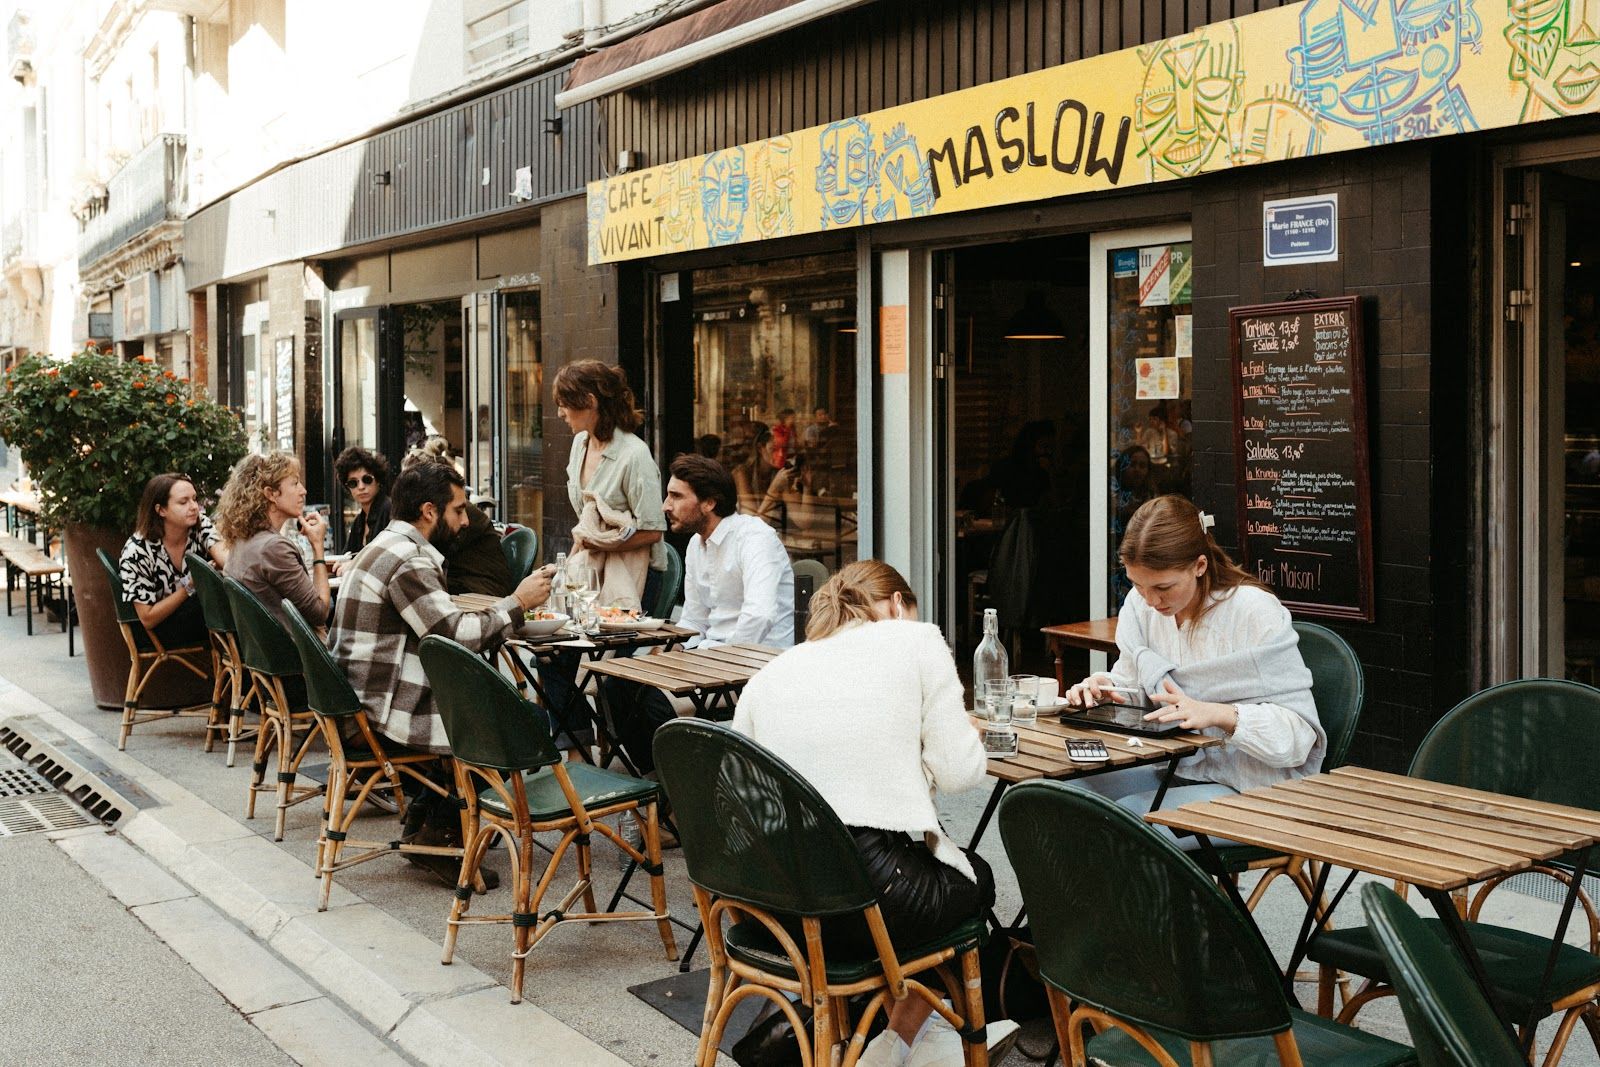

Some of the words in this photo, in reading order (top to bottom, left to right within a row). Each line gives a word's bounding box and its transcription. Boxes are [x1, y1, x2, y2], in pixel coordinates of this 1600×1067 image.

[927, 99, 1131, 199] MASLOW
[608, 172, 652, 213] CAFE
[600, 216, 664, 256] VIVANT
[1272, 222, 1289, 230] Marie
[1290, 220, 1314, 228] FRANCE
[1242, 318, 1276, 338] Tartines
[1314, 312, 1345, 326] EXTRAS
[1245, 440, 1280, 460] Salades
[1258, 559, 1276, 586] Fait
[1280, 562, 1315, 591] Maison
